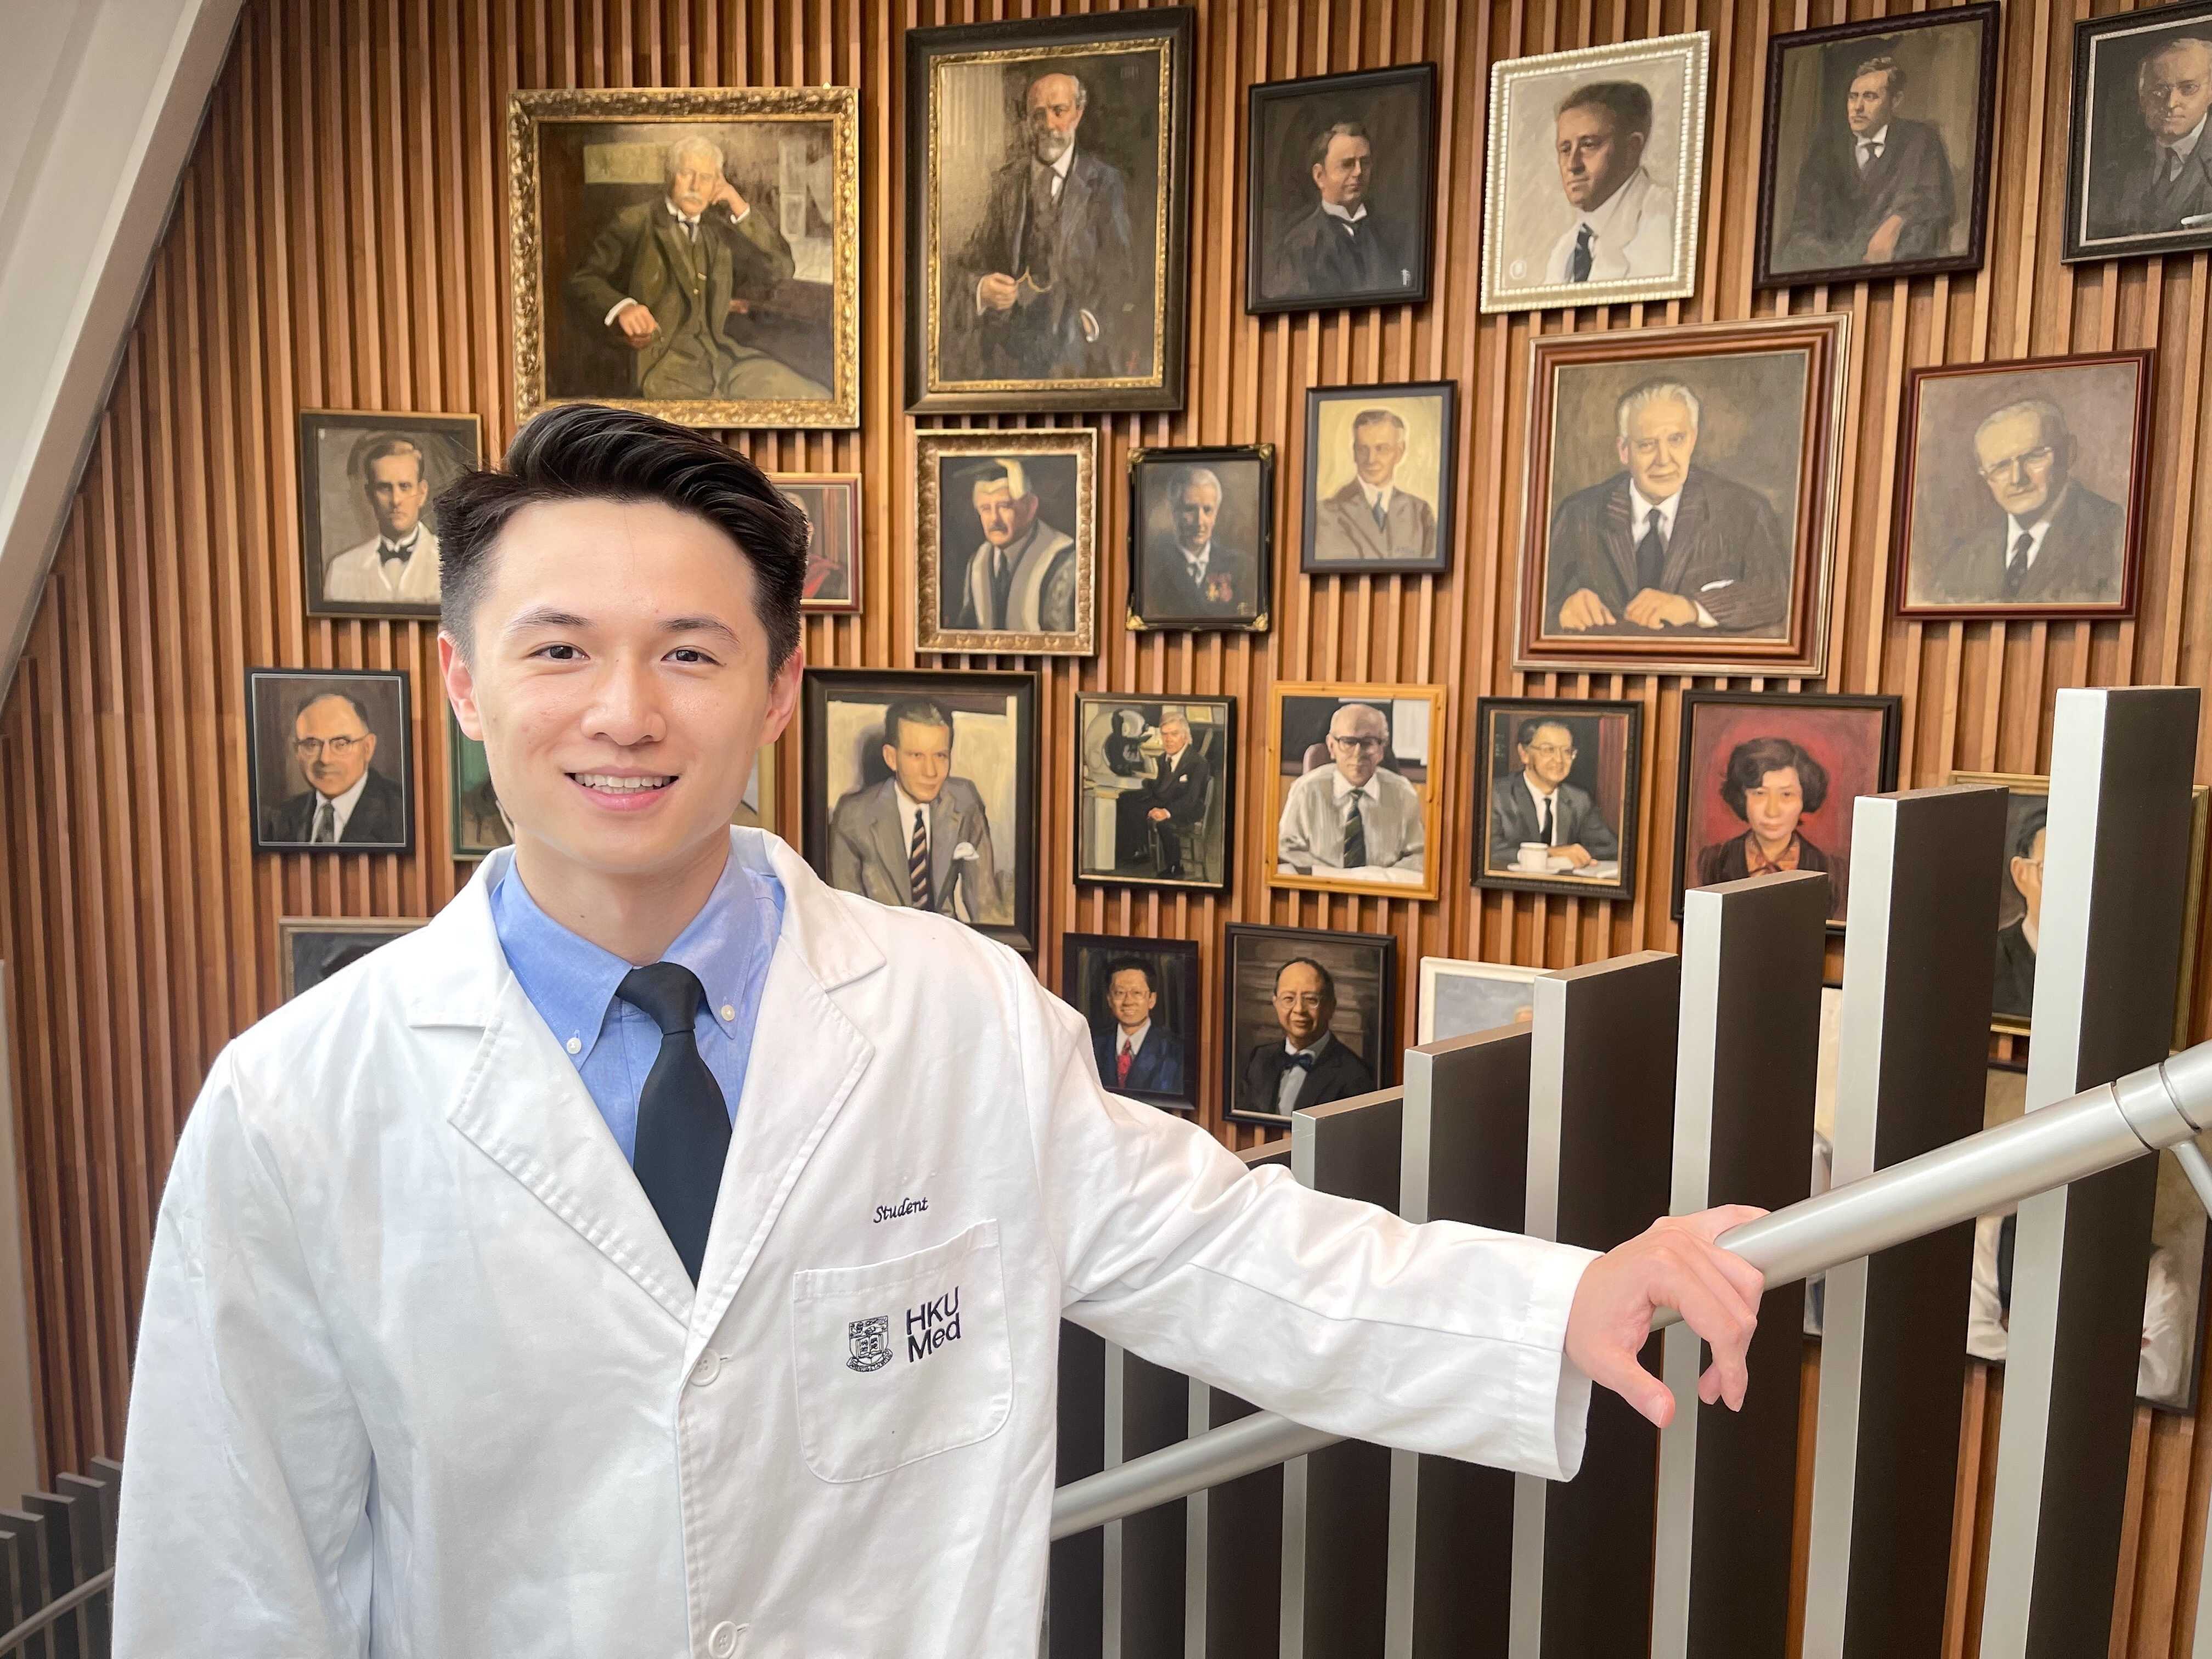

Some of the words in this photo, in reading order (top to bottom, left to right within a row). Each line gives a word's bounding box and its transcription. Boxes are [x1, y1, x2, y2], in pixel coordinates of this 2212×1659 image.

[873, 1197, 929, 1223] Student
[906, 1286, 959, 1335] HKU
[907, 1312, 961, 1363] Med
